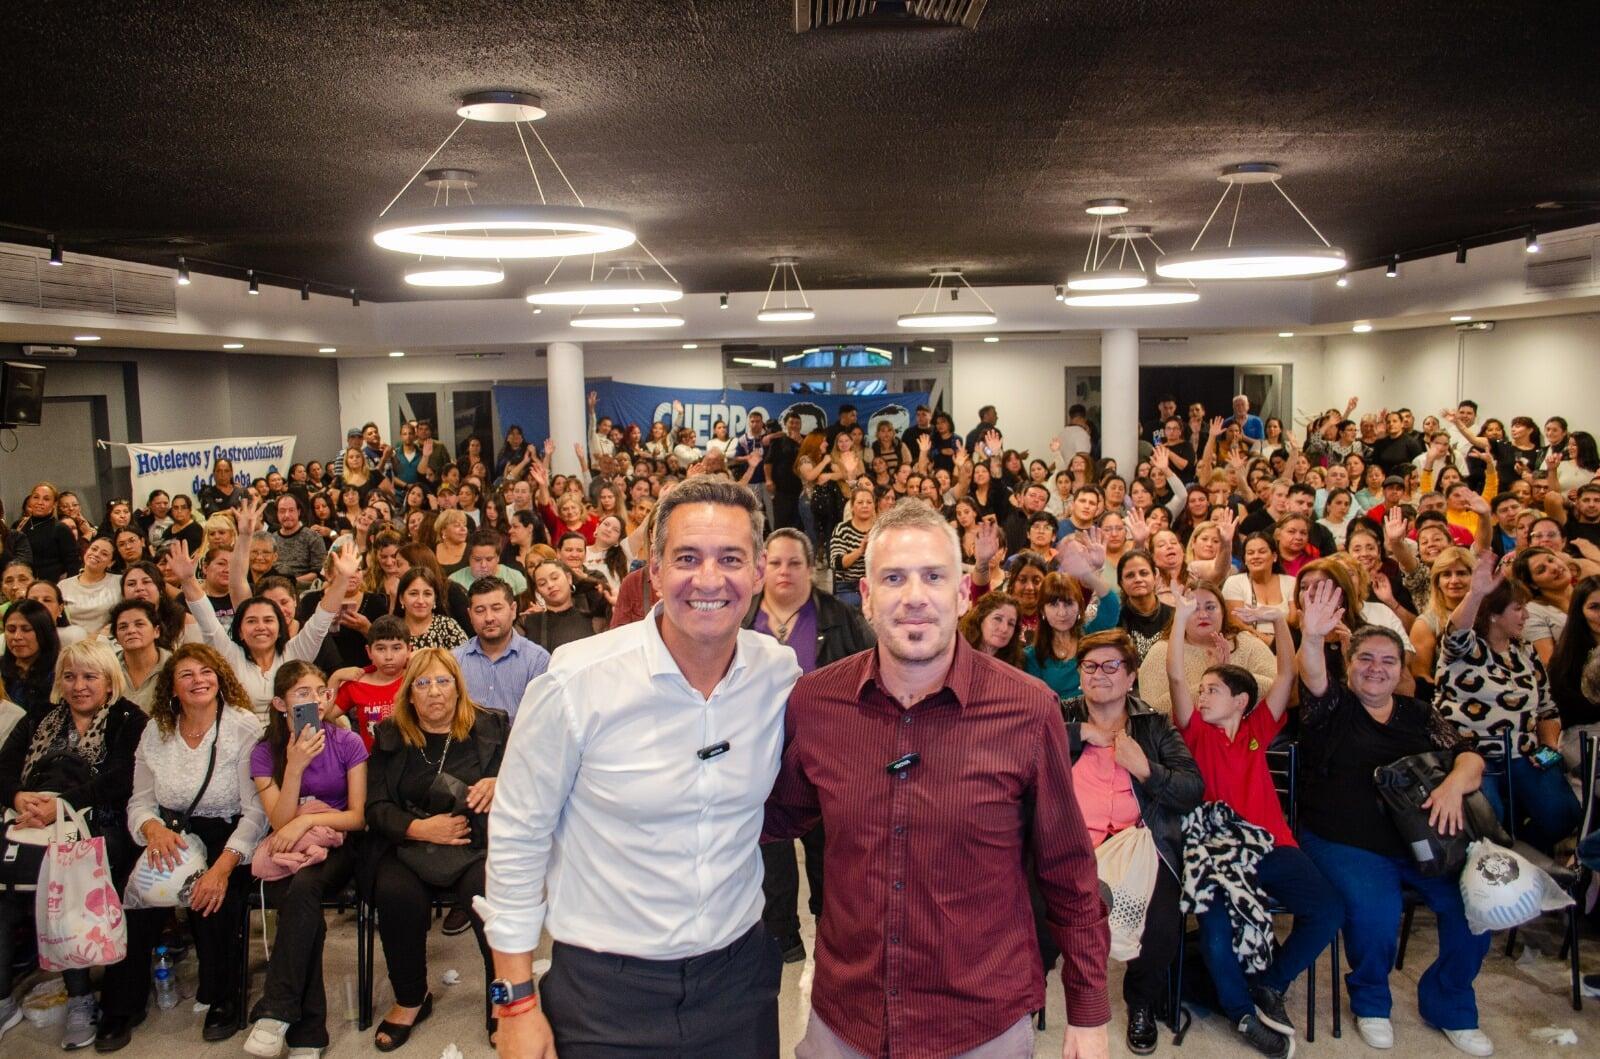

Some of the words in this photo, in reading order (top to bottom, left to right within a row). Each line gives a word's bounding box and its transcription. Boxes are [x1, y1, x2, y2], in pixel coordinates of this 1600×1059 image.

[137, 448, 201, 475] Hoteleros
[203, 450, 211, 469] y
[213, 442, 284, 461] Gastronómicos
